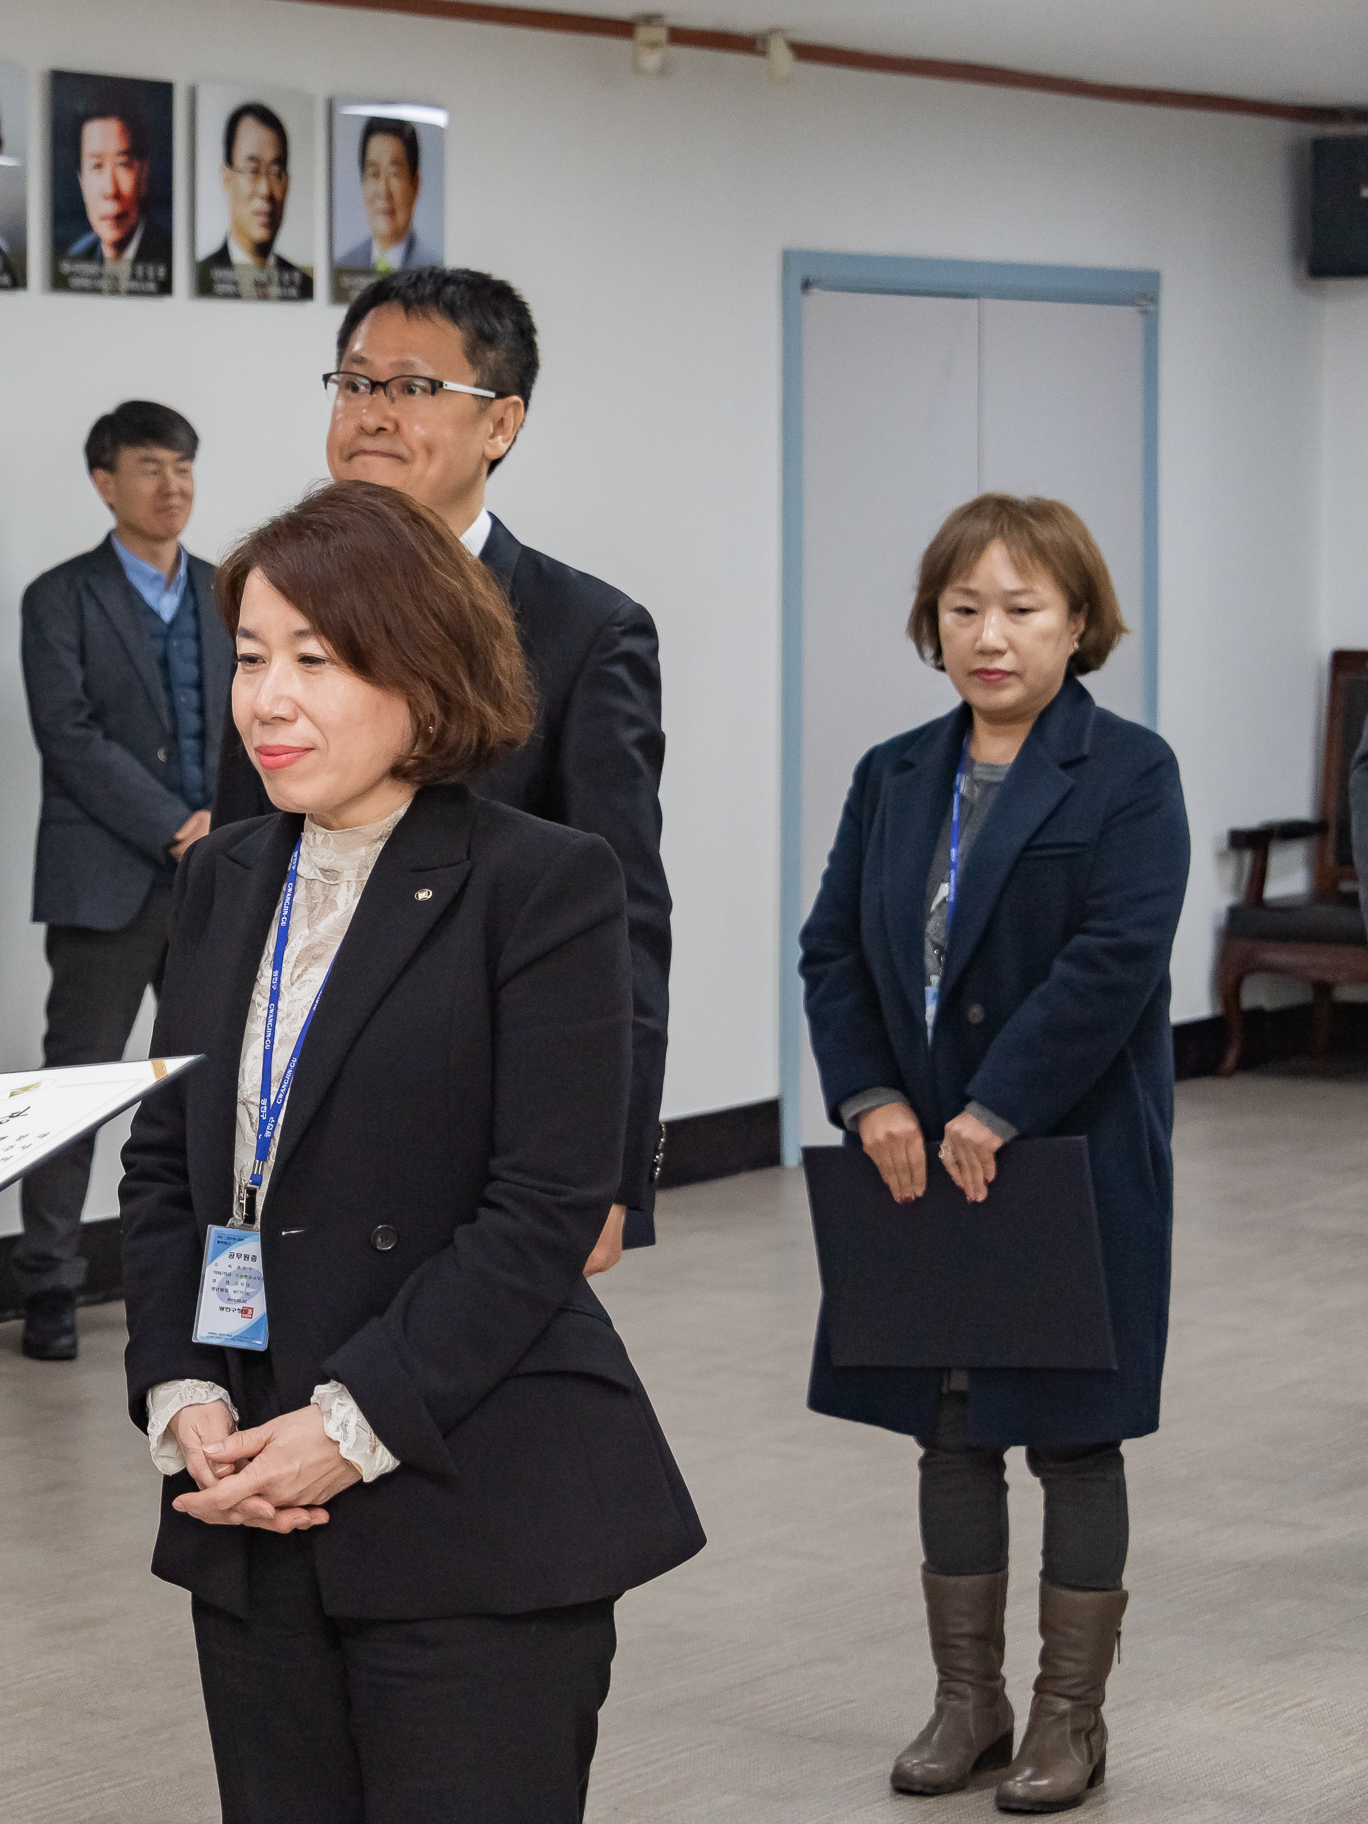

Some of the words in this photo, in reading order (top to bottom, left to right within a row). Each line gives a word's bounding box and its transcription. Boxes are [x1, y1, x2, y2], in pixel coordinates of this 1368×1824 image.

[271, 969, 279, 990] 광진구
[260, 1098, 268, 1120] 광진구
[228, 1251, 258, 1262] 공무원증
